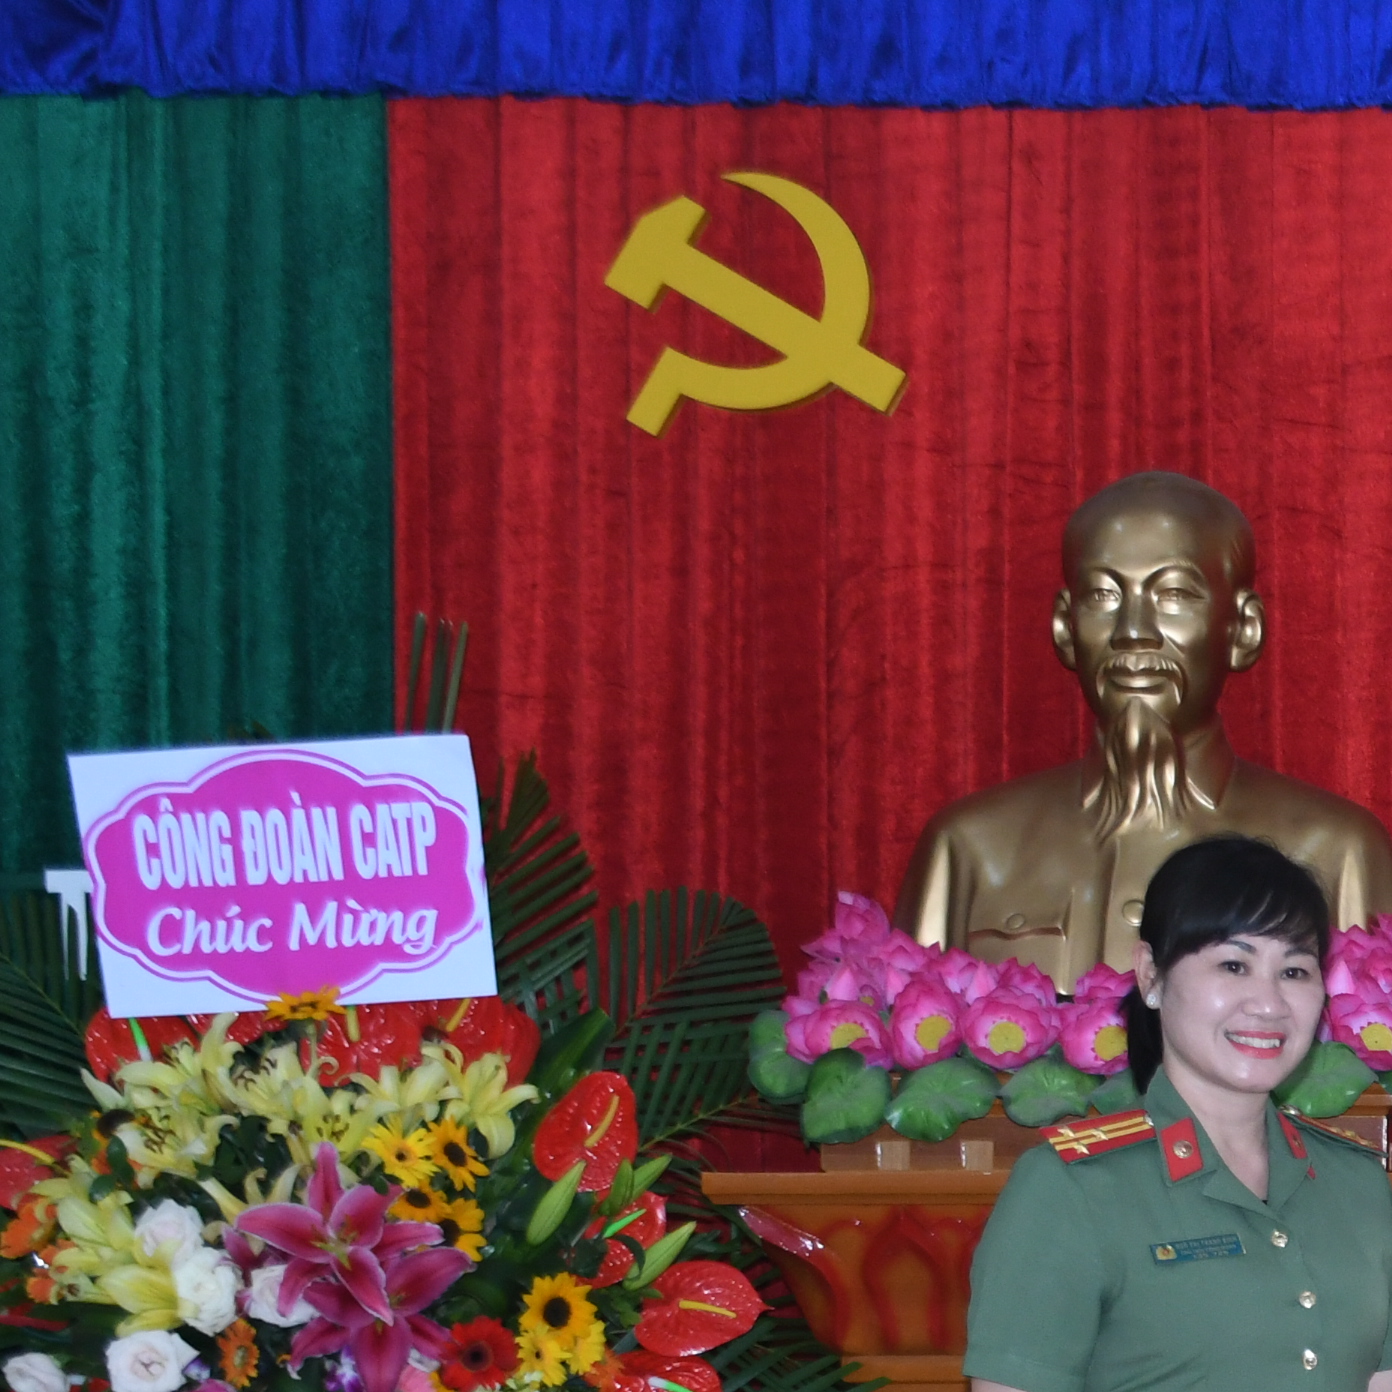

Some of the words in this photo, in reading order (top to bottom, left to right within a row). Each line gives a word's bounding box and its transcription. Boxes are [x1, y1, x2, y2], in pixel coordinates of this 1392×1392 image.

[133, 797, 236, 890] CÔNG
[240, 789, 344, 886] ĐOÀN
[350, 801, 436, 880] CATP
[145, 905, 273, 957] Chúc
[289, 898, 439, 955] Mừng
